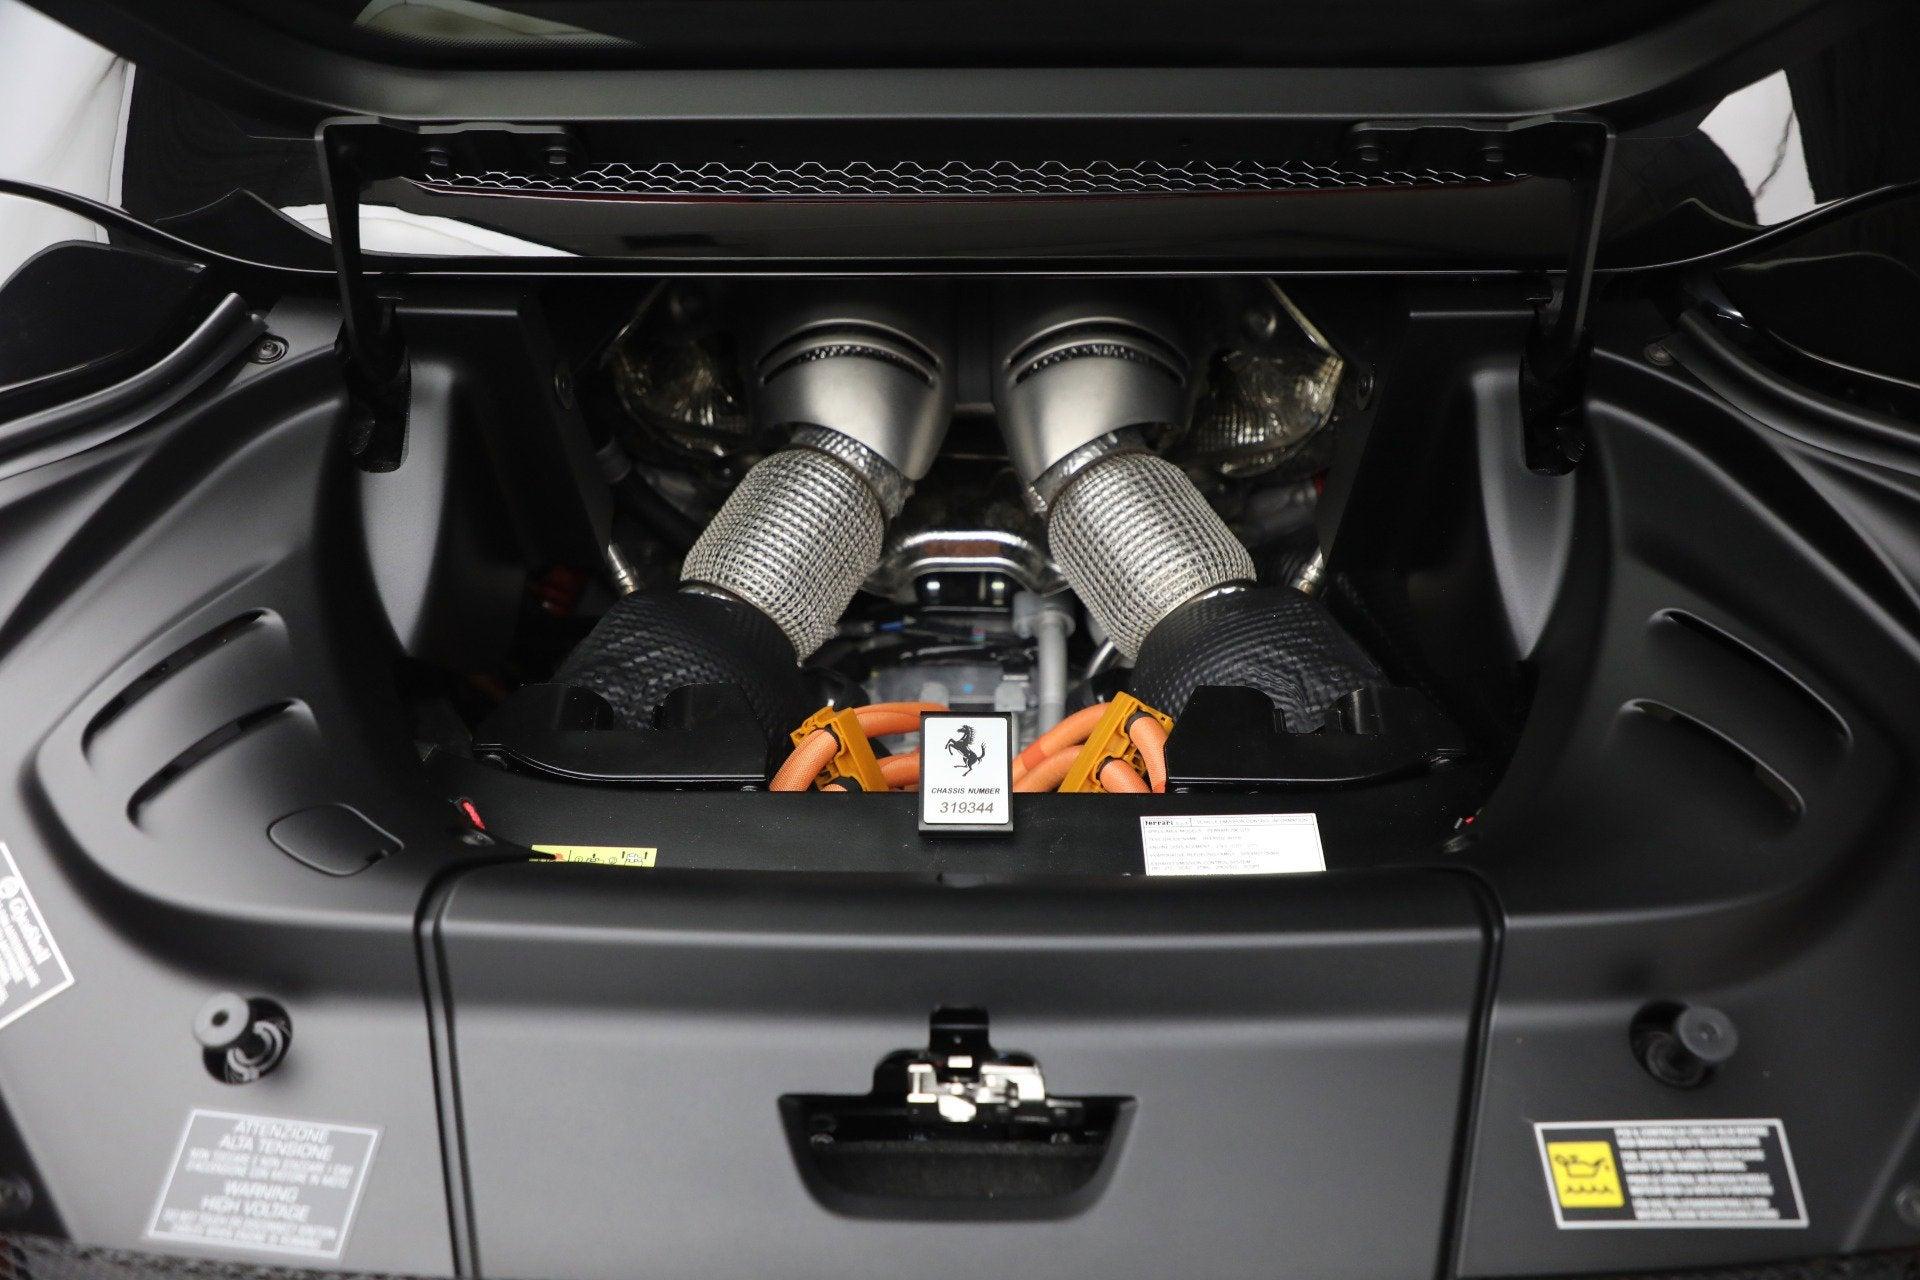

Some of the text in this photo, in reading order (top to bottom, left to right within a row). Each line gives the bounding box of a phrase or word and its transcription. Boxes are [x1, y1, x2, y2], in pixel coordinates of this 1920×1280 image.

[930, 787, 1001, 795] CHASSIS NUMBER
[939, 801, 994, 814] 319344
[224, 1180, 300, 1203] WARNING
